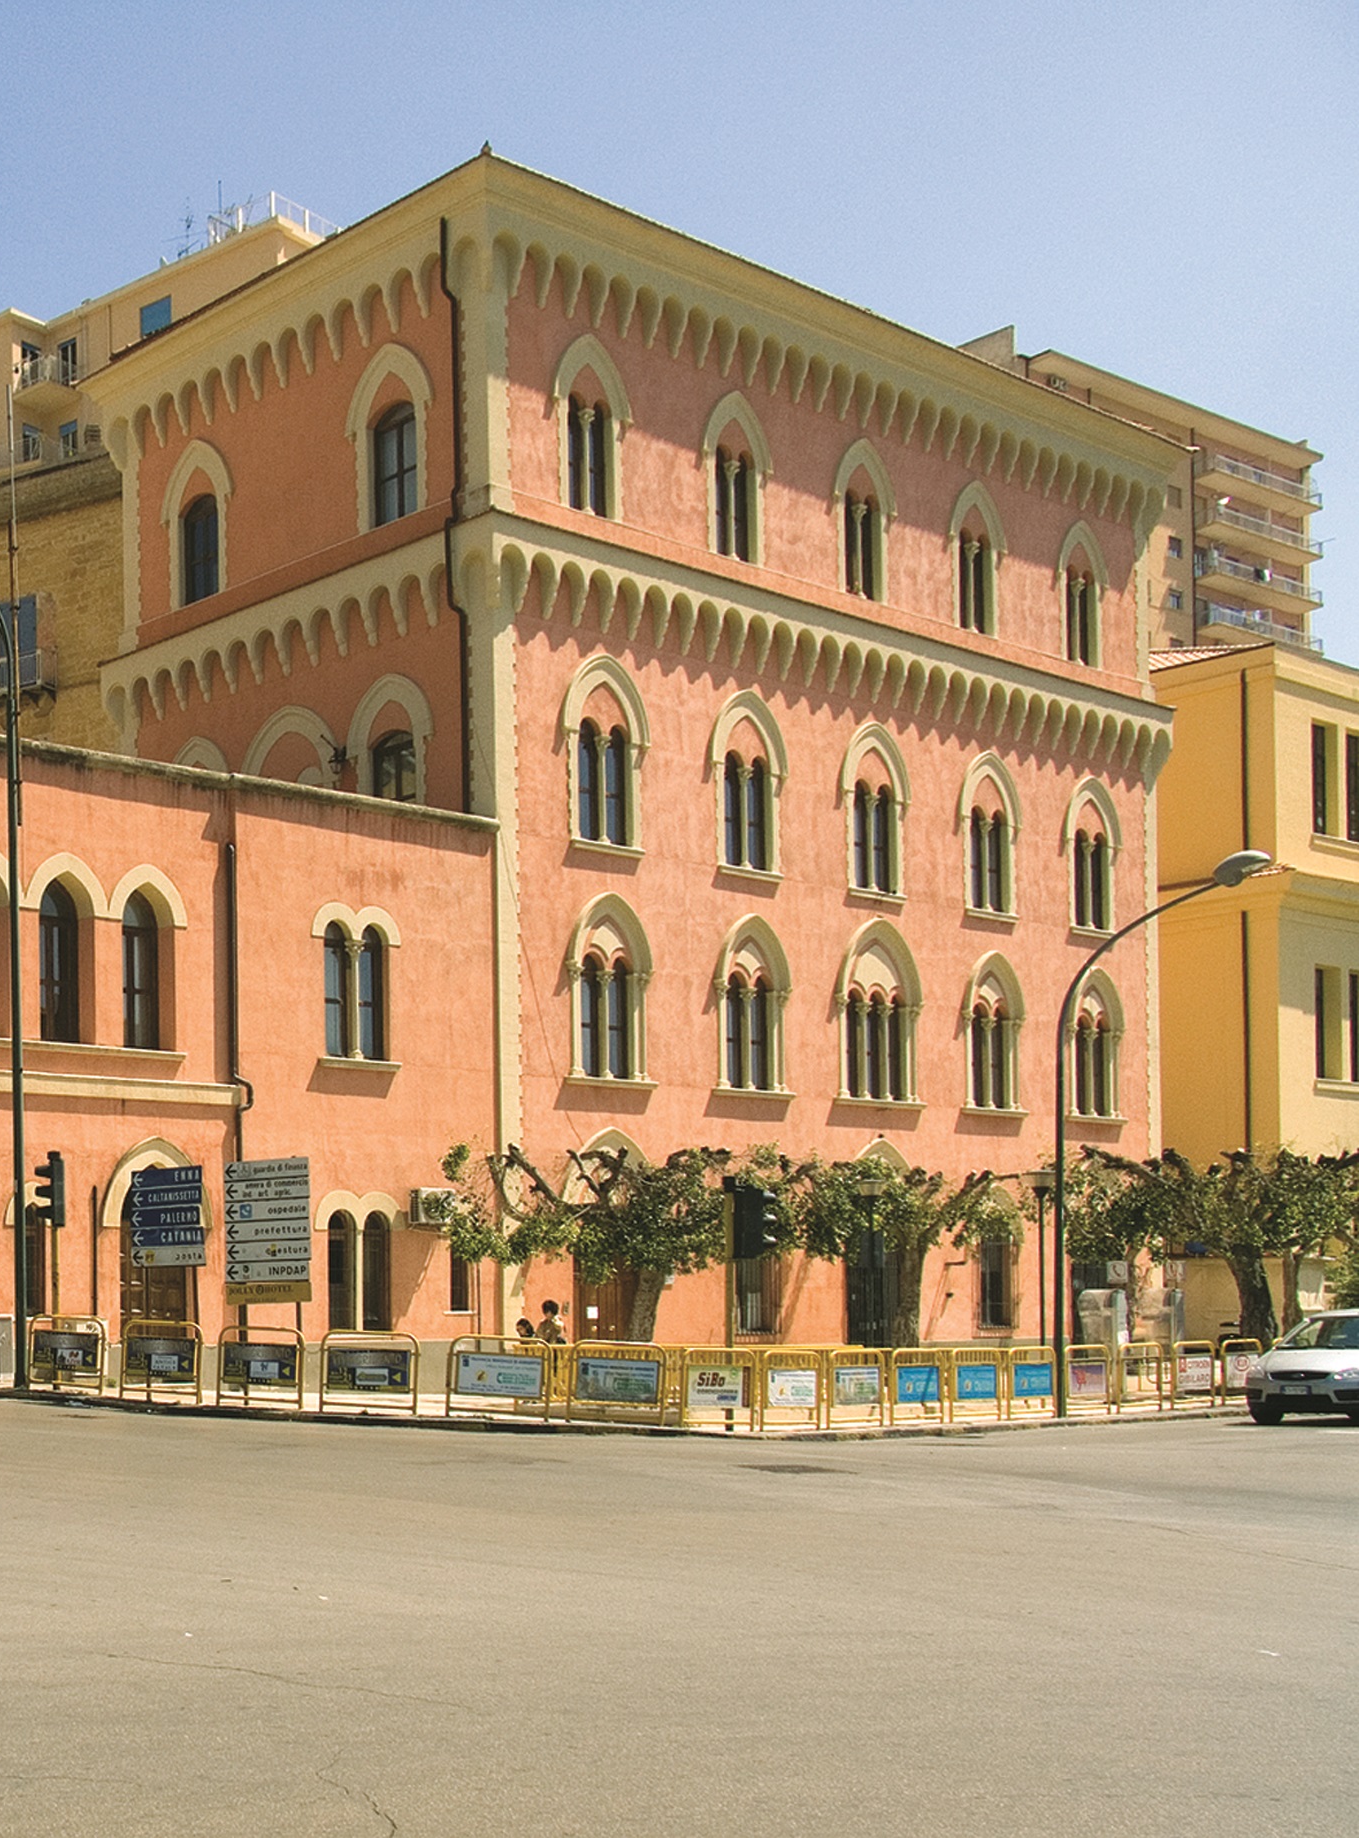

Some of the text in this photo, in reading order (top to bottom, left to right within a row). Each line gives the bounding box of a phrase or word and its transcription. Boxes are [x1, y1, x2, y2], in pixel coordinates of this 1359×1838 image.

[174, 1169, 200, 1182] ENNA
[147, 1189, 200, 1203] CALTANISSETTA
[267, 1204, 307, 1216] ospedale
[160, 1210, 198, 1224] PALERMO
[160, 1230, 203, 1243] CATANIA
[254, 1225, 308, 1236] prefettura
[265, 1245, 309, 1257] qestura
[268, 1264, 307, 1276] INPDAP
[696, 1371, 726, 1388] SiBo
